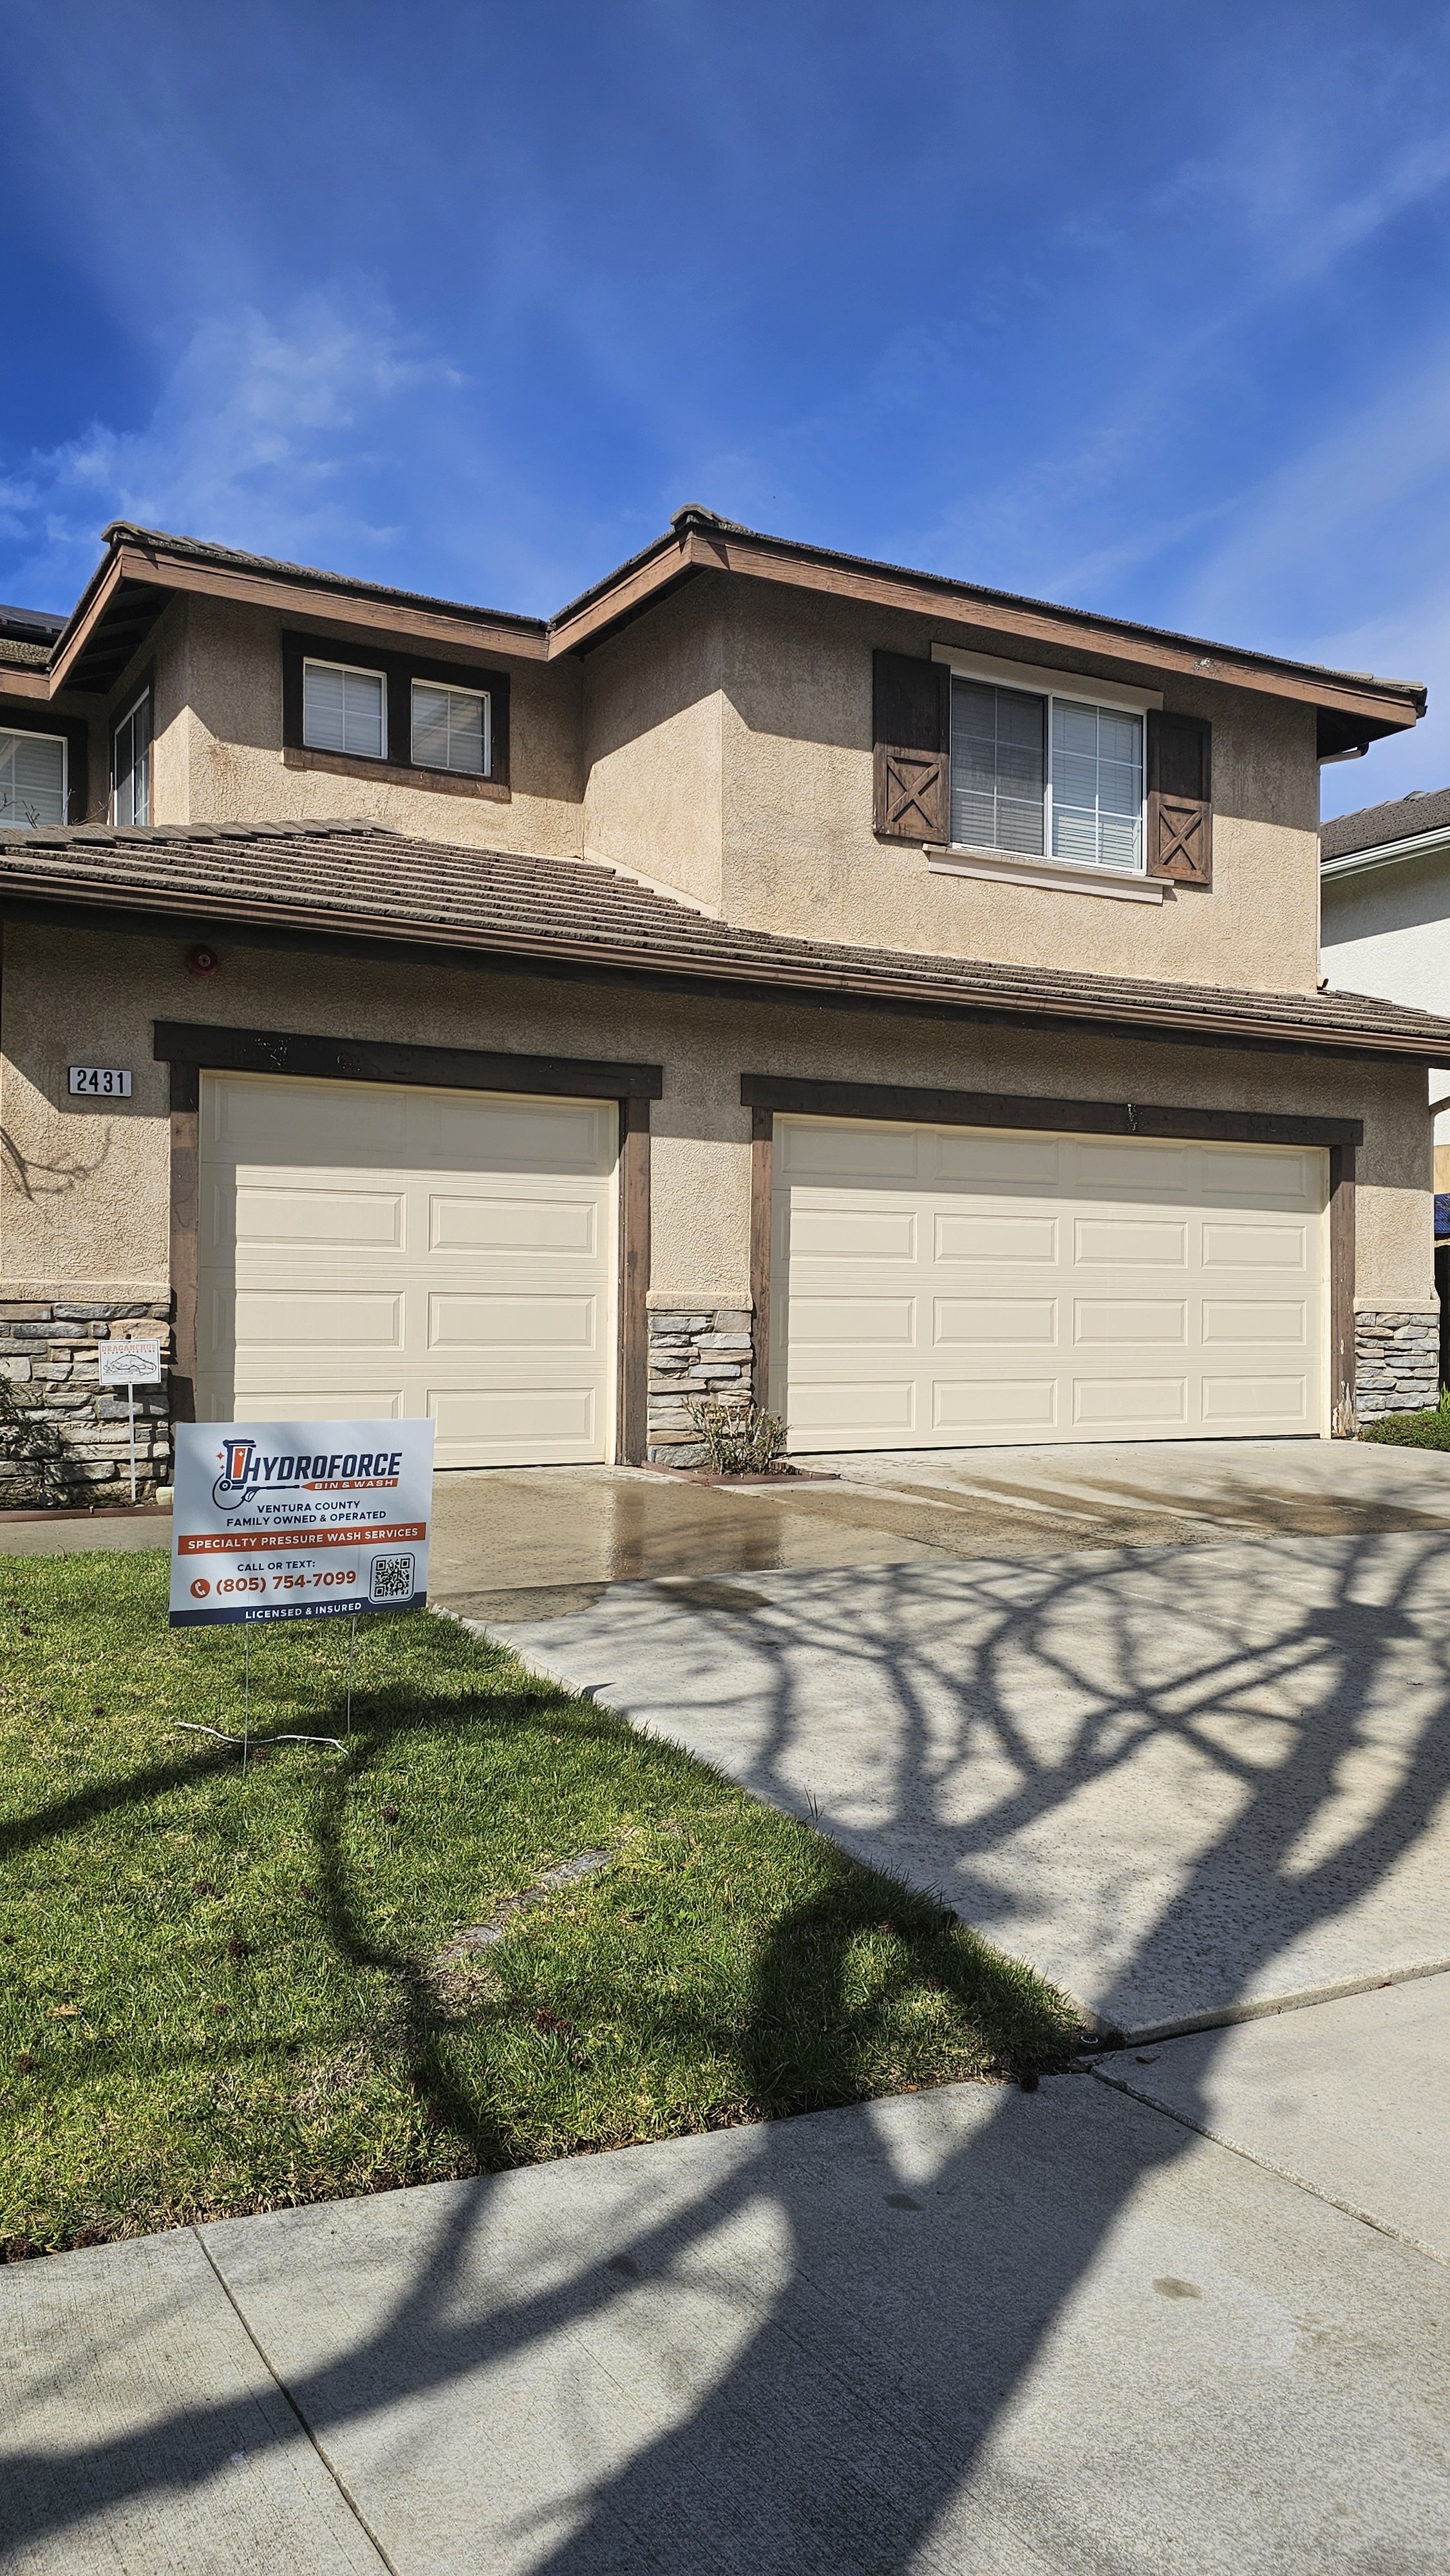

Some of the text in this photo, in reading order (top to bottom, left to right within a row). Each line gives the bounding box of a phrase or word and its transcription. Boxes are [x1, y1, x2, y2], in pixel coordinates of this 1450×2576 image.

[77, 1070, 123, 1093] 2431
[244, 1452, 402, 1482] HYDROFORCE
[315, 1481, 340, 1490] BIN
[354, 1479, 394, 1488] WASH
[258, 1501, 361, 1513] VENTURA COUNTY
[227, 1517, 270, 1527] FAMILY
[274, 1515, 316, 1524] OWNED
[330, 1511, 386, 1521] OPERATED
[188, 1528, 418, 1549] SPECIALTY PRESSURE WASH SERVICES
[238, 1560, 315, 1571] CALL OR TEXT:
[216, 1571, 356, 1595] (805) 754-7099
[245, 1602, 361, 1619] LICENSED & INSURED
